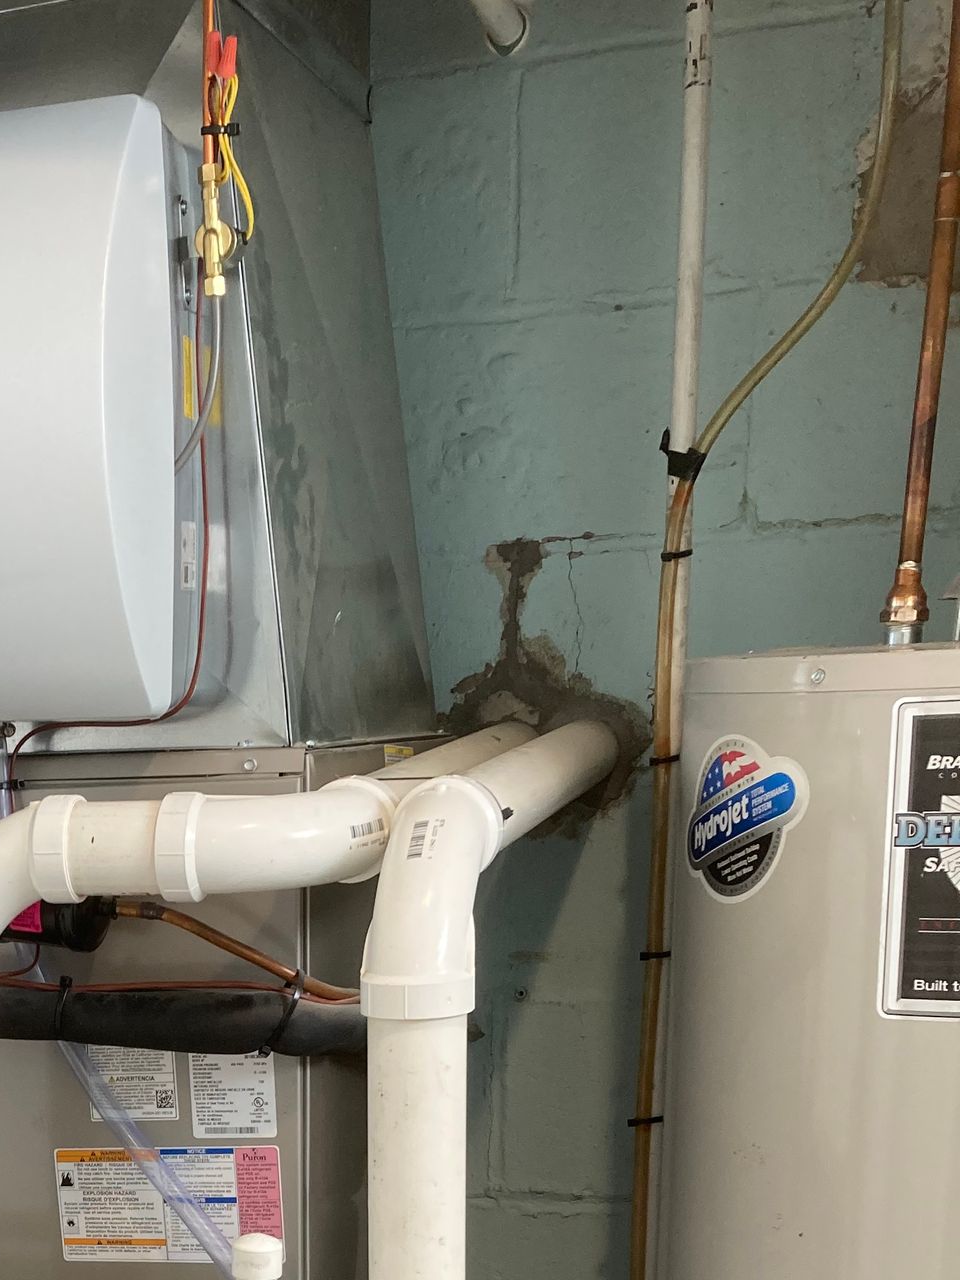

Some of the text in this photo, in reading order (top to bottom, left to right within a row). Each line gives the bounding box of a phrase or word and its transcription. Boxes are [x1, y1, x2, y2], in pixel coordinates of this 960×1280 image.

[751, 782, 790, 807] PERFORMANCE
[752, 800, 772, 817] SYSTEM
[694, 794, 749, 852] Hydrojet
[913, 979, 948, 991] Built
[242, 1153, 267, 1161] Puron
